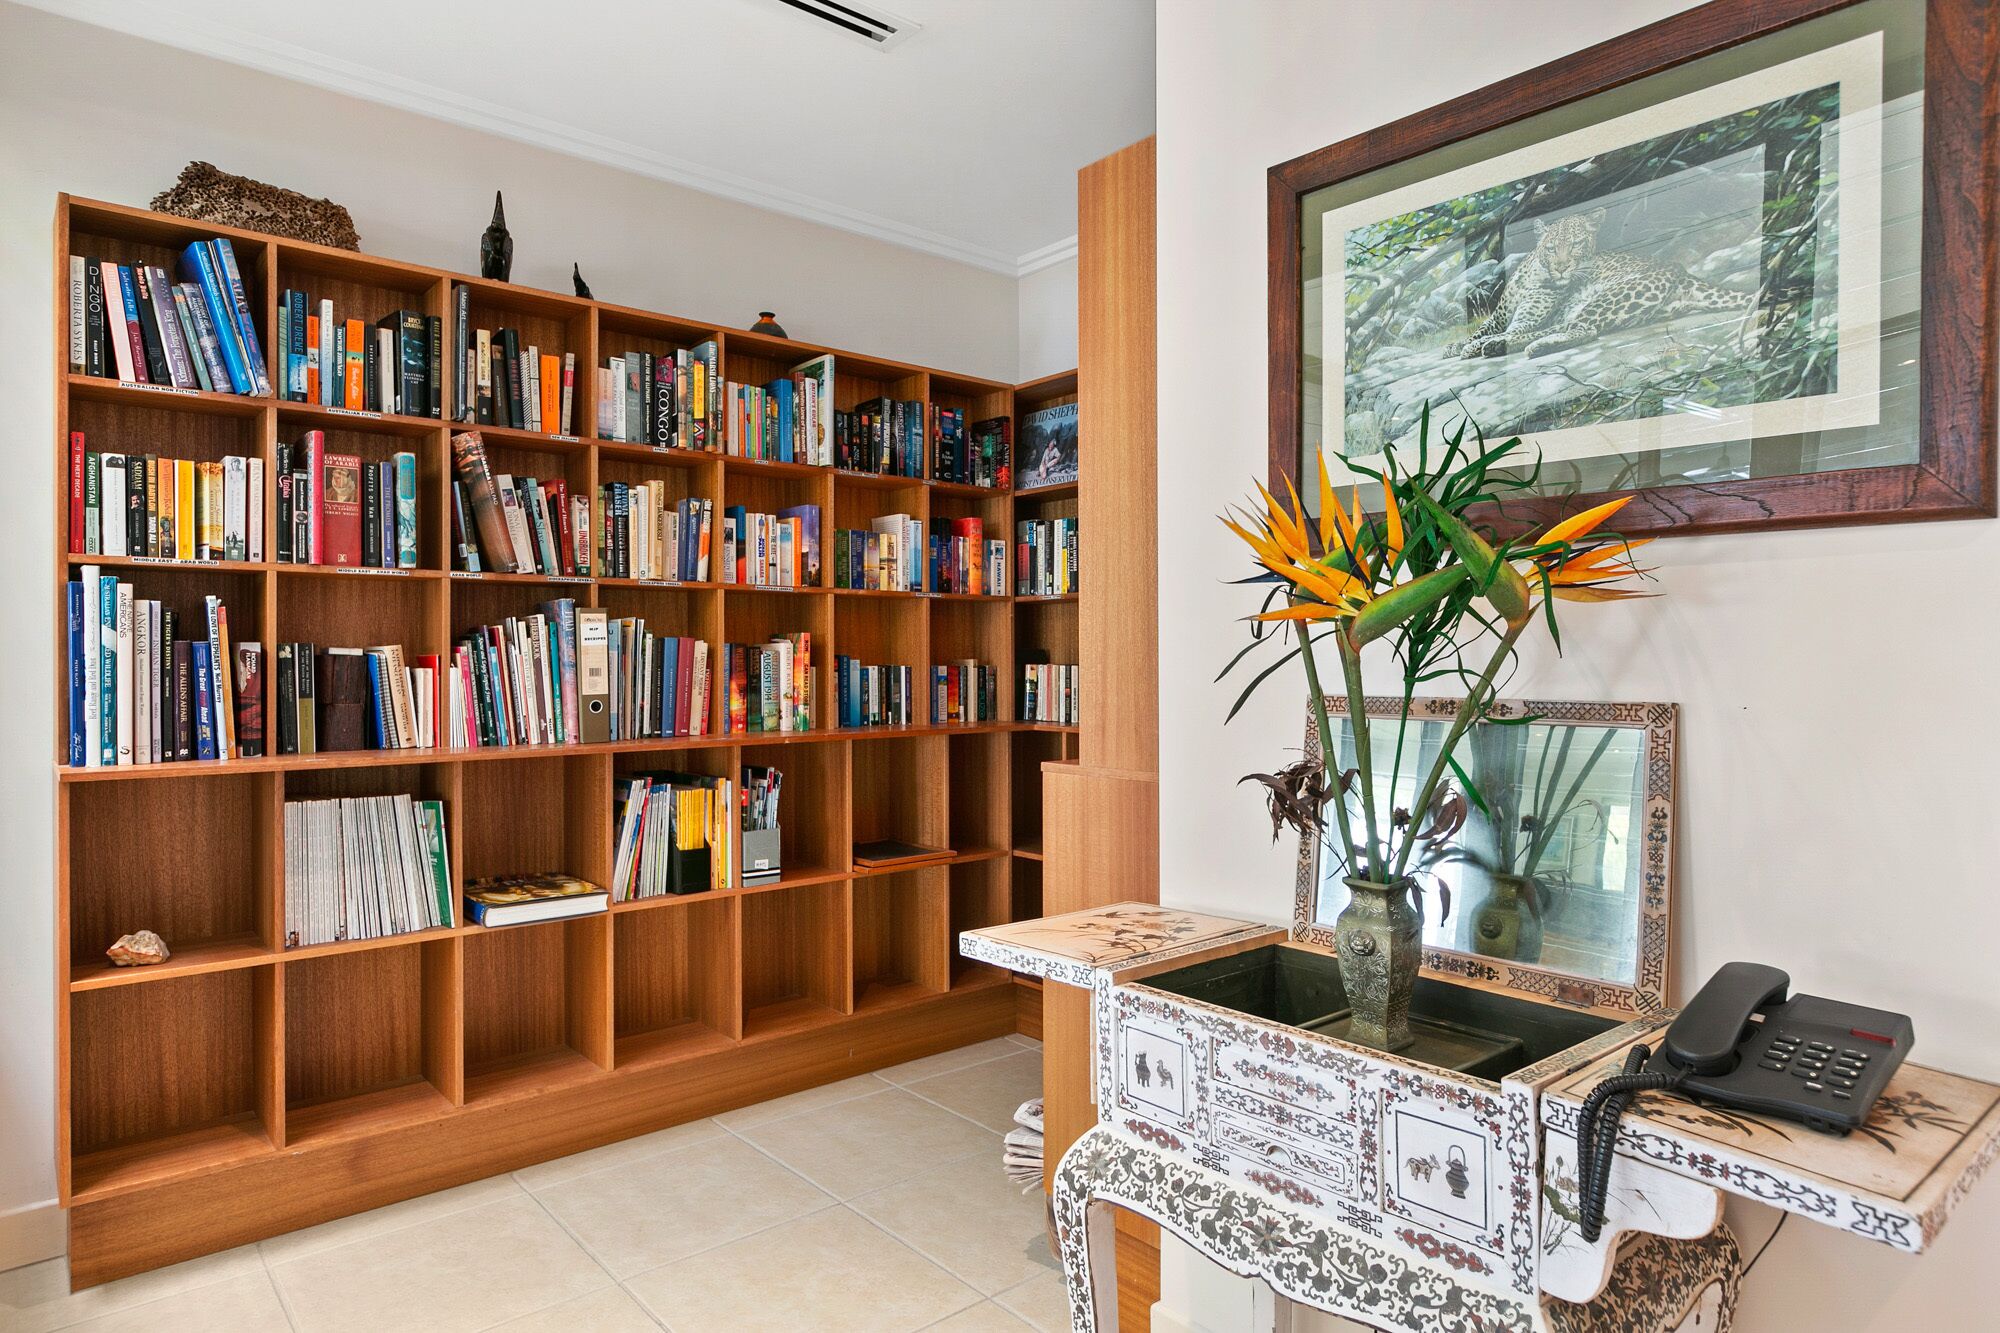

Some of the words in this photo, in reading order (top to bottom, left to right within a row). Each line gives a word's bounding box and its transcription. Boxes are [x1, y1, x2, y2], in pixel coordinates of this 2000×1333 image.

[89, 266, 100, 313] DINGO
[73, 280, 83, 329] ROBERTA
[294, 293, 303, 323] ROBERT
[73, 330, 83, 360] SYKES
[121, 383, 159, 391] AUSTRALIAN
[328, 408, 360, 416] AUSTRALIAN
[657, 389, 669, 441] CONGO
[1024, 412, 1048, 425] DAVID
[134, 461, 142, 490] SADDAM
[369, 495, 374, 503] OF
[614, 483, 622, 516] FRASER
[535, 521, 545, 544] Slave
[579, 530, 588, 565] UNBROKEN
[119, 592, 127, 639] AMERICANS
[565, 610, 574, 631] ITALY
[136, 610, 146, 655] ANGKOR
[212, 637, 220, 670] ELEPHANTS
[532, 641, 540, 659] BOOK
[104, 658, 112, 688] WILDLIFE
[179, 663, 187, 675] THE
[179, 675, 187, 700] ALLENS
[200, 706, 208, 723] Ahead
